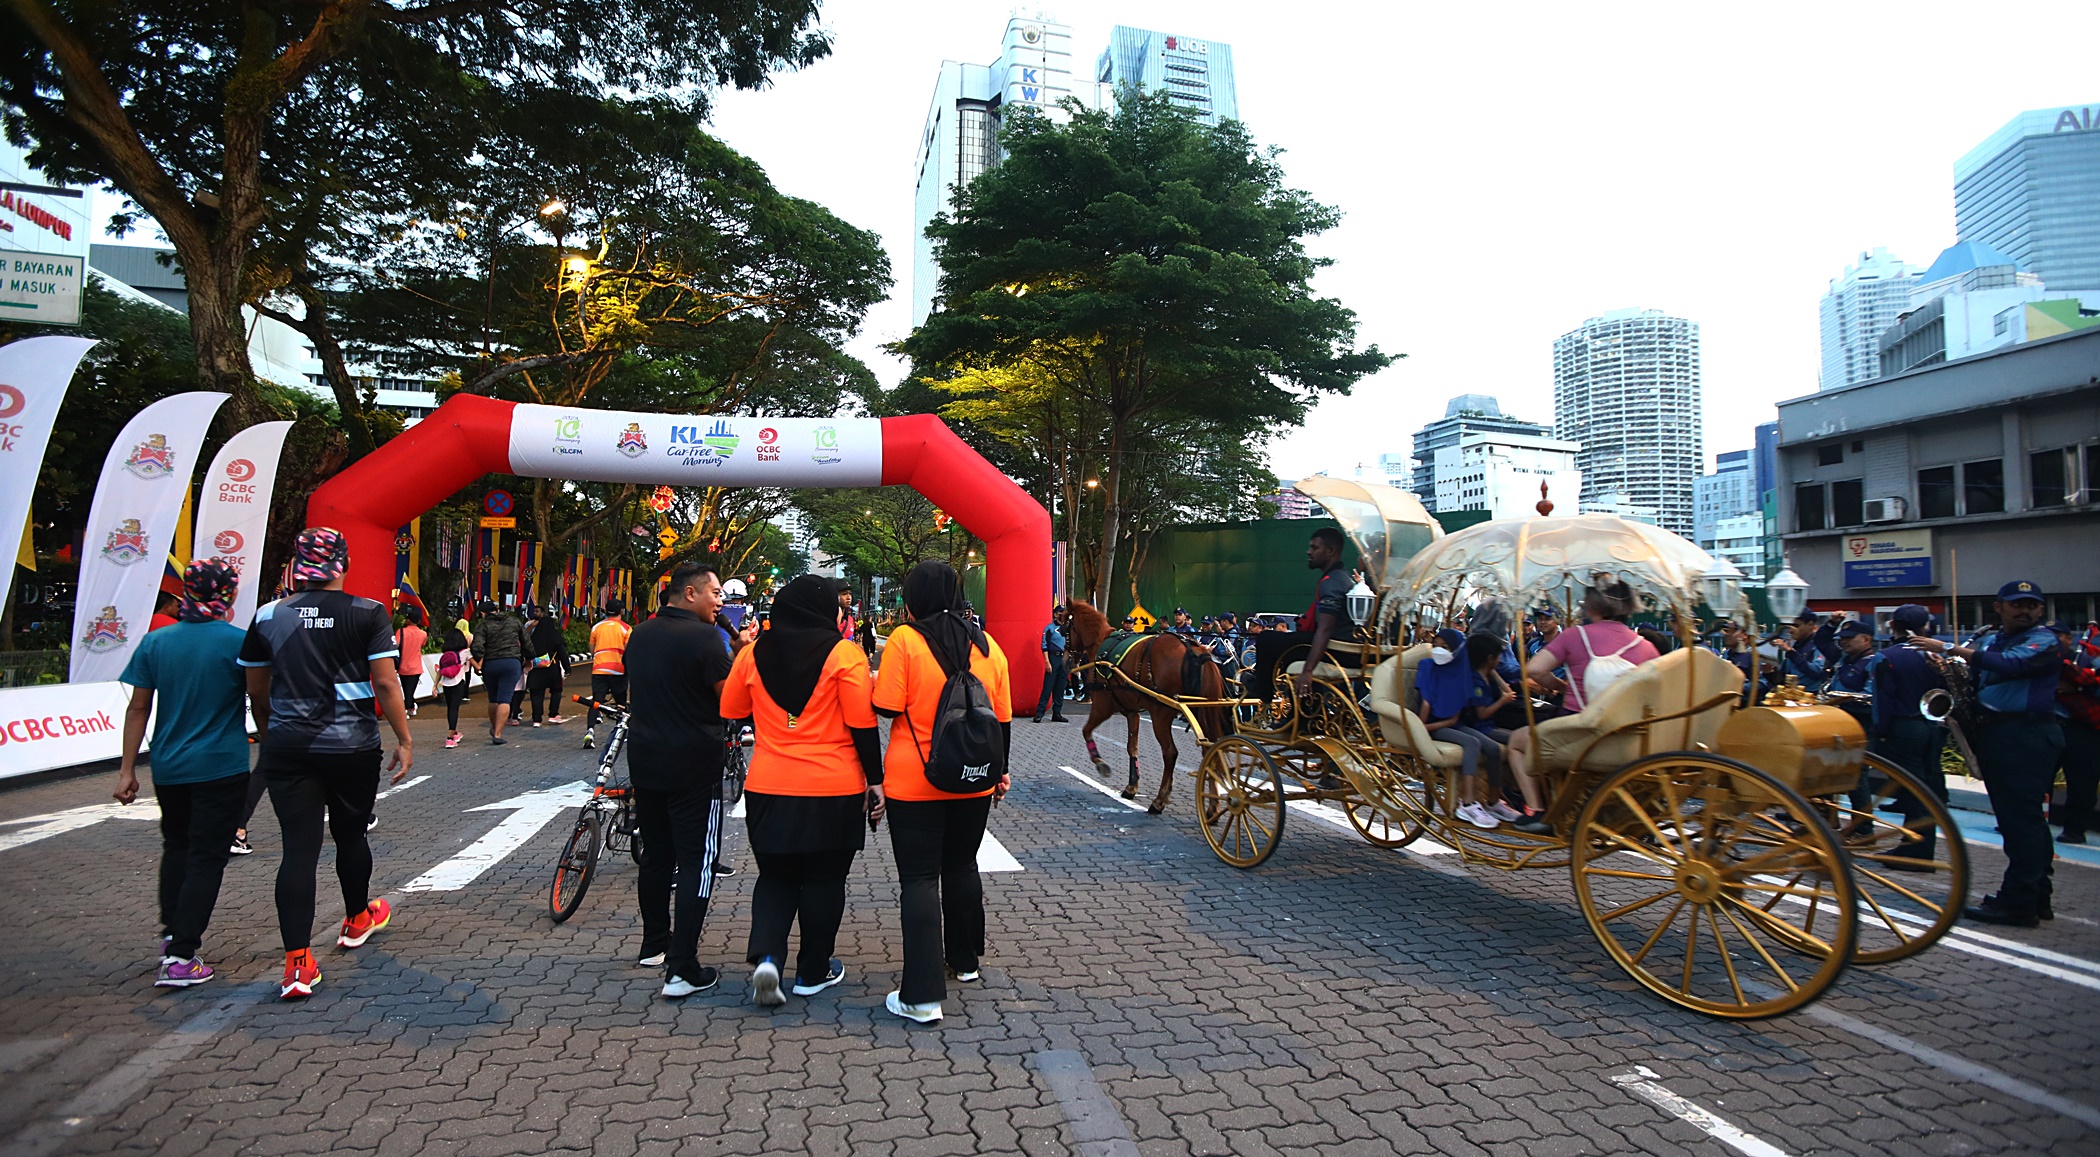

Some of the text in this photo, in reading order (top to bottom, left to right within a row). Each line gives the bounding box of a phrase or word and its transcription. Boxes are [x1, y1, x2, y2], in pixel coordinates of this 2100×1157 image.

[1180, 39, 1208, 55] UOB
[16, 197, 72, 242] LUMPUR
[14, 260, 73, 277] BAYARAN
[10, 279, 56, 294] MASUK
[670, 425, 703, 444] KL
[756, 445, 780, 453] OCBC
[682, 457, 723, 468] Morning
[757, 453, 780, 462] Bank
[218, 482, 257, 494] OCBC
[218, 492, 252, 504] Bank
[299, 607, 319, 617] ZERO
[304, 618, 334, 628] TO HERO
[58, 710, 117, 737] Bank
